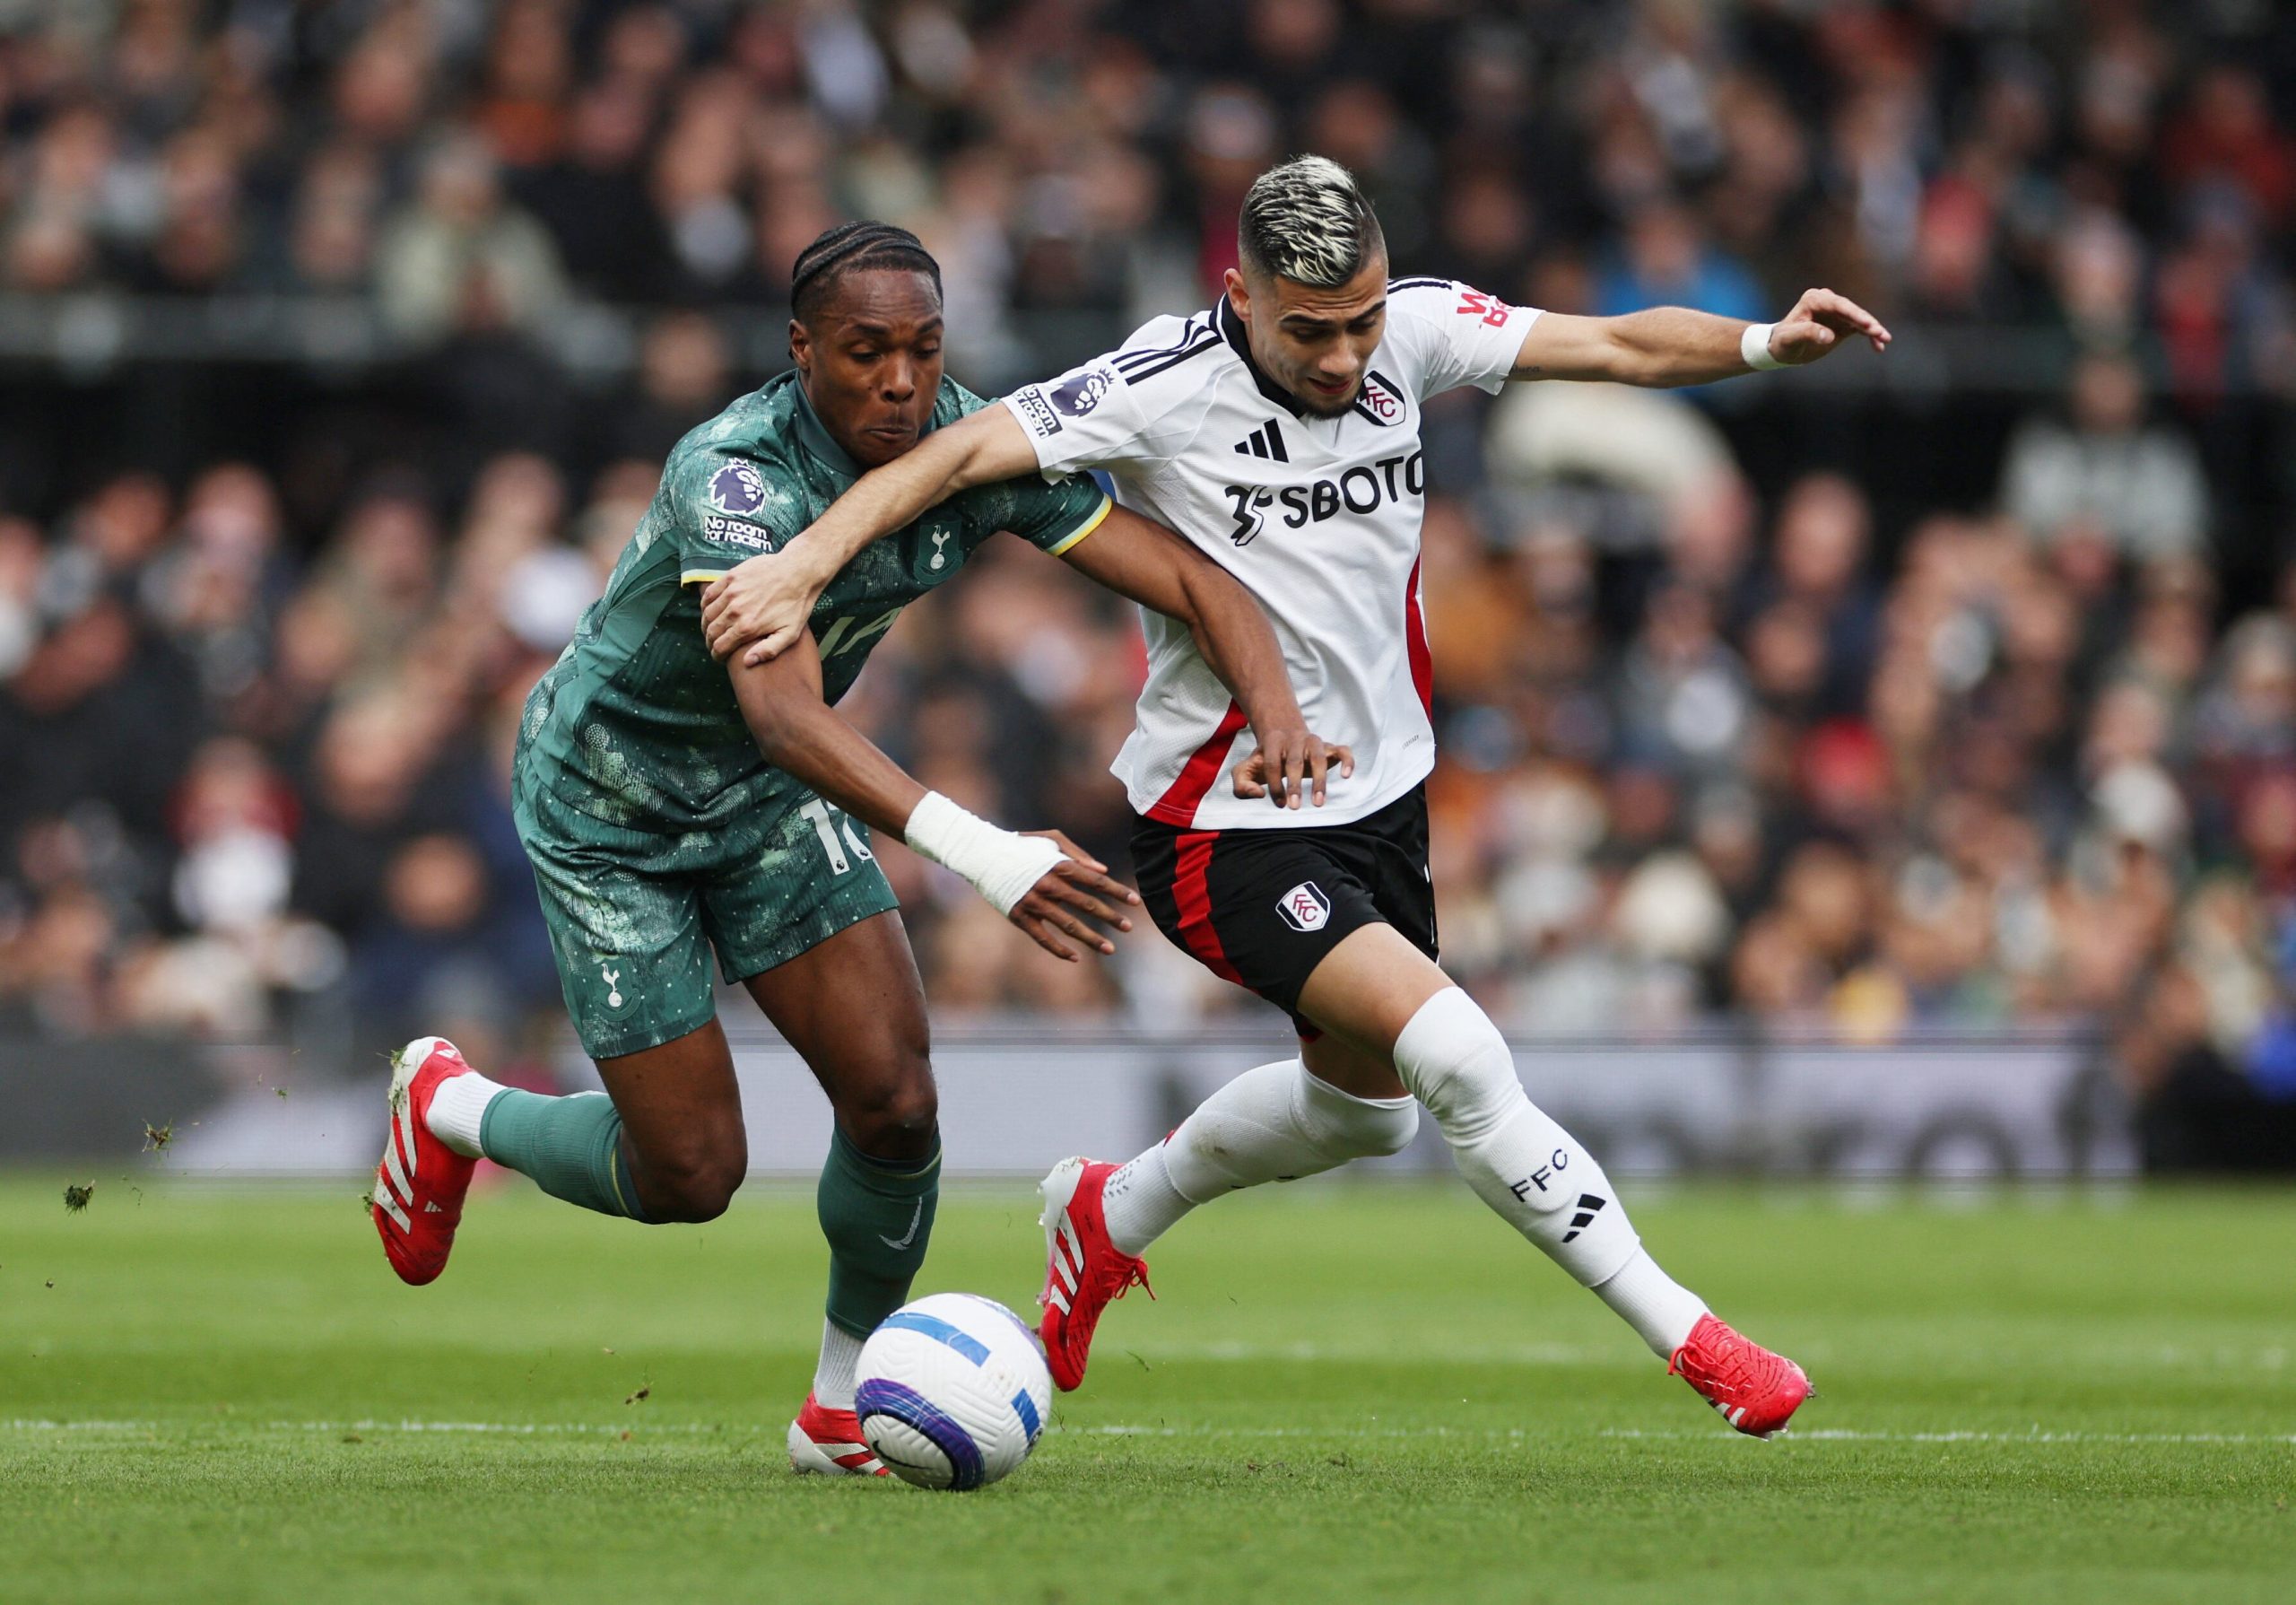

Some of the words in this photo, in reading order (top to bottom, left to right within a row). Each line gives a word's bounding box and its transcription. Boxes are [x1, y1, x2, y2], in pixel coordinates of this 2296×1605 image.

[1031, 397, 1057, 430] room
[1363, 385, 1396, 418] FFC
[704, 516, 726, 530] No
[727, 519, 769, 540] room
[704, 527, 724, 542] for
[724, 531, 773, 553] racism
[1292, 894, 1318, 922] FFC
[1510, 1148, 1569, 1203] FFC
